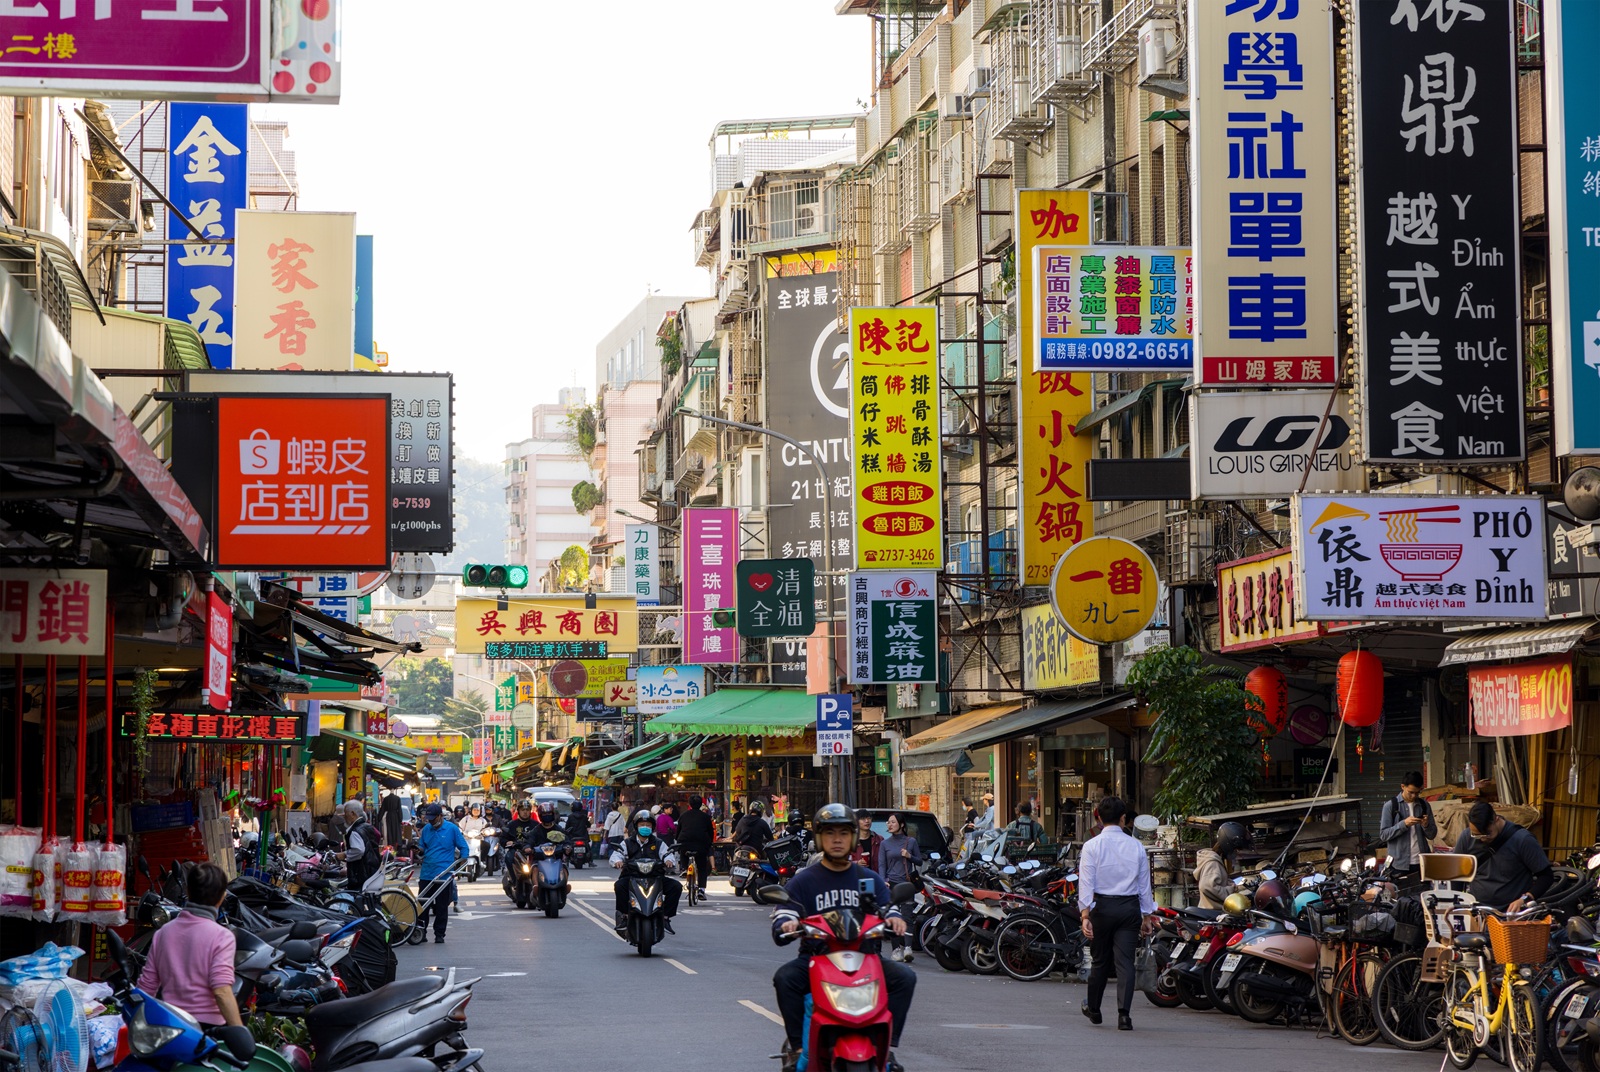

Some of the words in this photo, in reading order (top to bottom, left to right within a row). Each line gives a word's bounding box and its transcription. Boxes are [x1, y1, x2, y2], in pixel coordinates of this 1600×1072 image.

[0, 32, 78, 60] 二樓
[1451, 194, 1472, 220] Y
[173, 115, 242, 347] 金益五
[264, 238, 319, 370] 家香
[1046, 255, 1072, 334] 店面設計
[1080, 255, 1107, 335] 專業施工
[1115, 255, 1142, 336] 油漆窗簾
[1150, 255, 1177, 336] 屋頂防水
[859, 317, 930, 356] 陳記
[1386, 191, 1444, 456] 越式美食
[1217, 359, 1323, 381] 山姆家族
[860, 374, 882, 474] 筒仔米糕
[884, 374, 908, 474] 佛跳牆
[910, 374, 933, 474] 排骨酥湯
[286, 436, 369, 476] 蝦皮
[1458, 436, 1505, 456] Nam
[1209, 454, 1265, 475] LOUIS
[1269, 452, 1352, 474] GARNEAU
[239, 480, 370, 522] 店到店
[872, 485, 925, 502] 雞肉飯
[872, 515, 926, 533] 魯肉飯
[634, 529, 650, 596] 力康藥局
[879, 548, 936, 562] 2737-3426
[1317, 526, 1372, 608] 依鼎
[1488, 547, 1518, 573] Y
[1069, 557, 1144, 596] 一番
[1375, 582, 1468, 597] 越式美食
[1475, 576, 1535, 604] Đỉnh
[881, 589, 894, 598] 信
[917, 588, 930, 598] 成
[1442, 598, 1467, 609] Nam
[476, 609, 619, 636] 吳興商圈
[1081, 602, 1140, 625] カレー
[855, 577, 870, 680] 吉興商行經銷處
[641, 680, 700, 698] 冰山一角
[1520, 674, 1538, 700] 特價
[1537, 663, 1572, 720] 100
[820, 698, 838, 721] P
[1301, 757, 1324, 766] Uber
[1301, 767, 1325, 776] Eats
[815, 889, 839, 912] GAP
